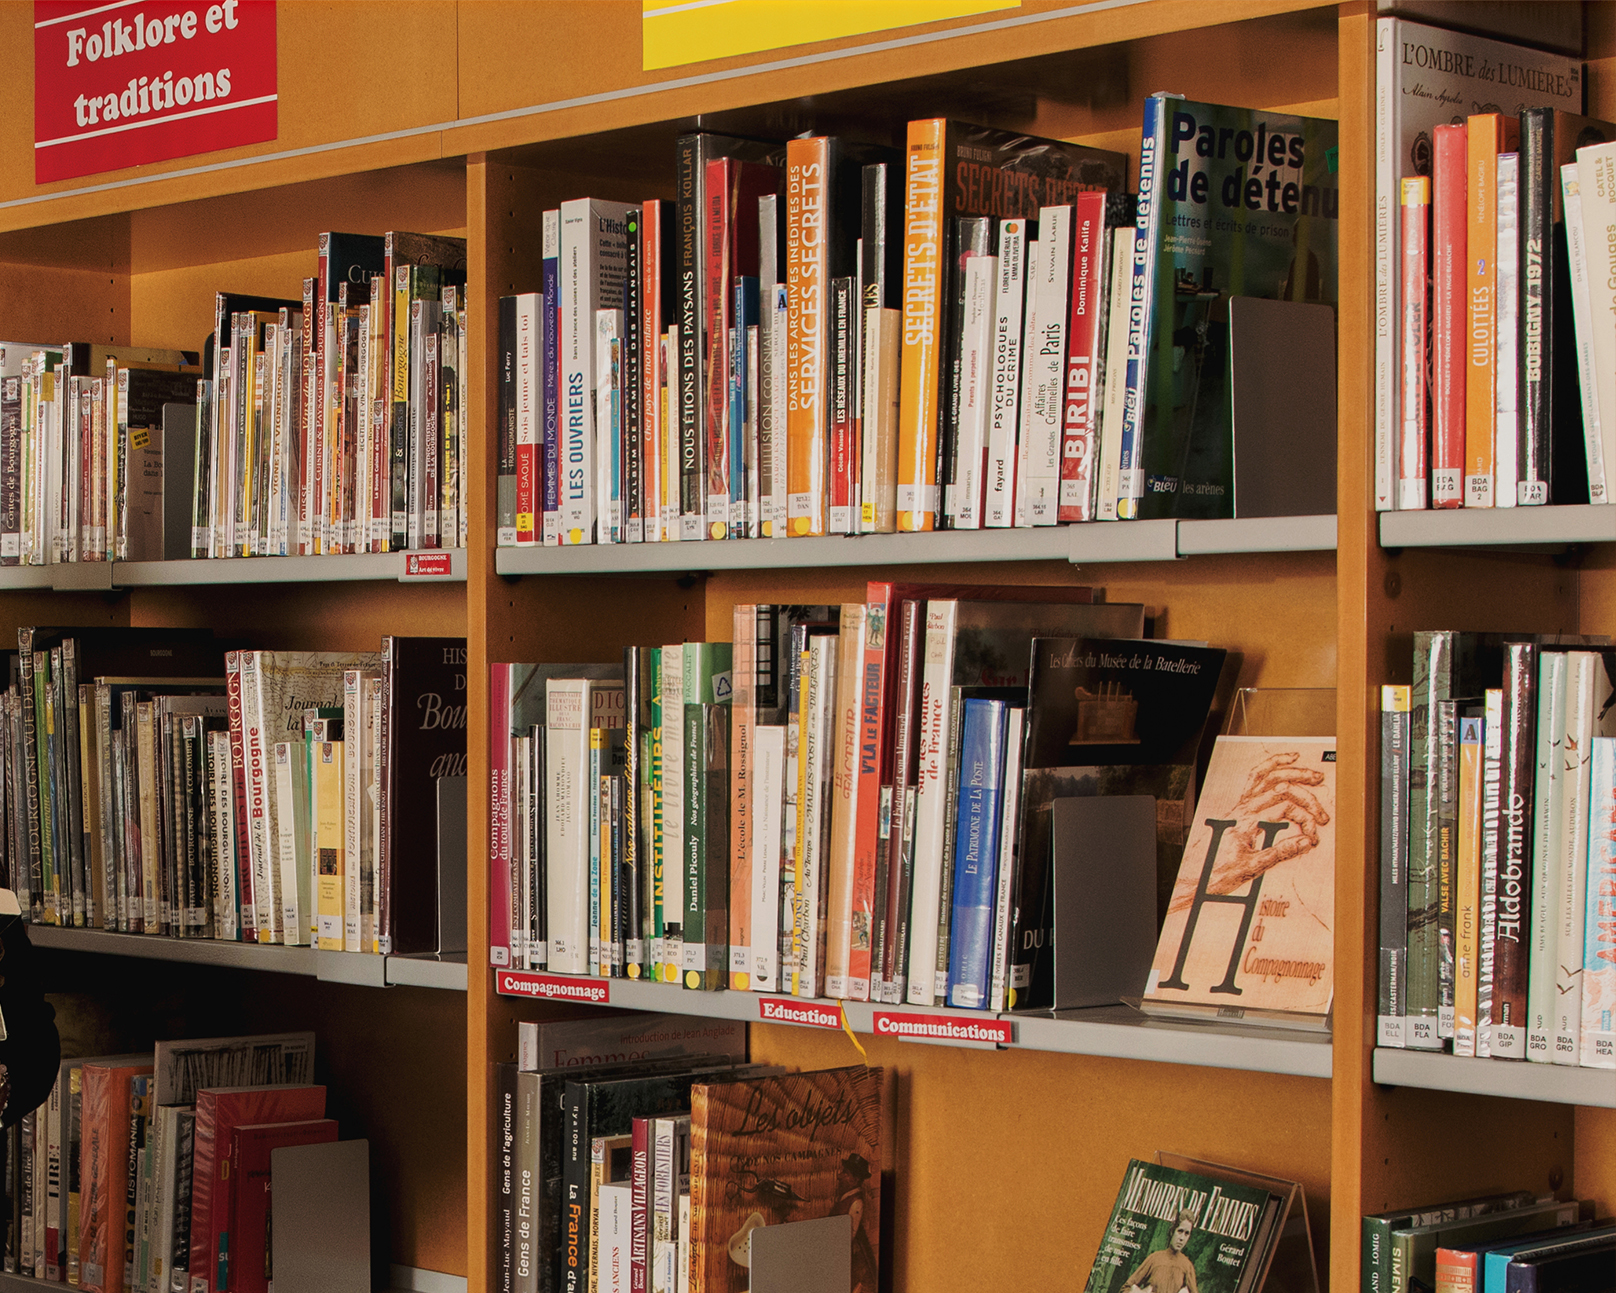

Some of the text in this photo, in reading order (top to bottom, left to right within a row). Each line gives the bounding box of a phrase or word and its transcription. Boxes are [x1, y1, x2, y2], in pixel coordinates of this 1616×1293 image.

[66, 0, 238, 67] Folklore et
[74, 65, 231, 128] traditions
[1402, 42, 1574, 98] L'OMBRE des LUMIÈRES
[1171, 111, 1305, 169] Paroles
[1166, 164, 1338, 218] de détenu
[905, 154, 935, 346] SECRETS D'ÉTAT
[1076, 220, 1090, 314] Dominique Kalifa
[1127, 137, 1155, 358] Paroles de détenus
[788, 165, 799, 411] DANS LES ARCHIVES INÉDITES DES
[801, 162, 821, 409] SERVICES SECRETS
[1526, 239, 1542, 381] BOBIGNY 1972
[1039, 323, 1061, 354] Paris
[1473, 286, 1489, 366] CULOTTÉES
[682, 270, 694, 468] NOUS ÉTIONS DES PAYSANS
[993, 316, 1008, 428] PSYCHOLOGUES
[1006, 338, 1017, 407] DU CRIME
[569, 372, 583, 498] LES OUVRIERS
[1064, 355, 1090, 457] BIRIBI
[251, 727, 262, 819] Bourgogne
[1498, 793, 1524, 942] Aldobrando
[504, 977, 606, 1000] Compagnonnage
[1243, 946, 1325, 983] Compagnonnage
[763, 1004, 838, 1027] Education
[878, 1018, 1005, 1042] Communications
[786, 1085, 855, 1138] objets
[569, 1183, 578, 1199] La
[631, 1151, 646, 1264] ARTISANS VILLAGEOIS
[1187, 1185, 1259, 1241] DE FEMMES
[568, 1204, 581, 1267] France
